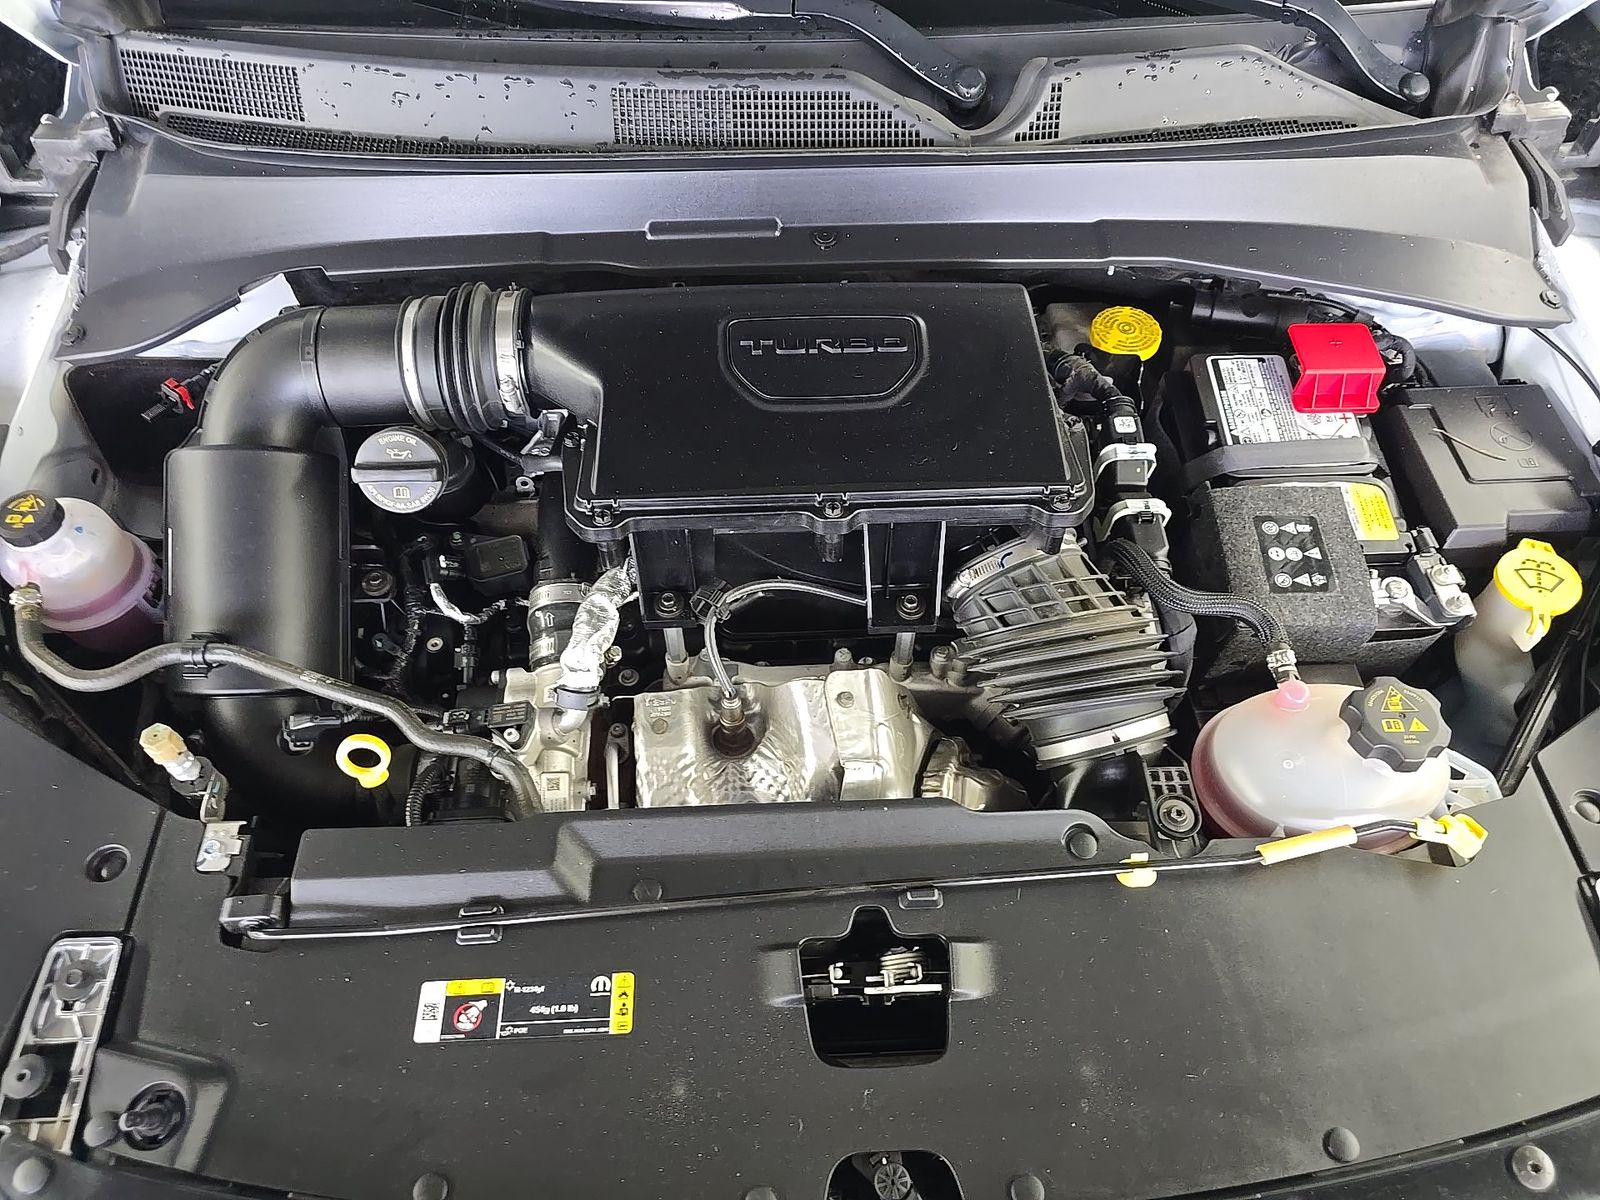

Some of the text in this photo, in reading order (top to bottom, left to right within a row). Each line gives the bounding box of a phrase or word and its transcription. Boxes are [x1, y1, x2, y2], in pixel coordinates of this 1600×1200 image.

[739, 337, 909, 356] TURBO
[377, 433, 418, 446] ENGINE OIL
